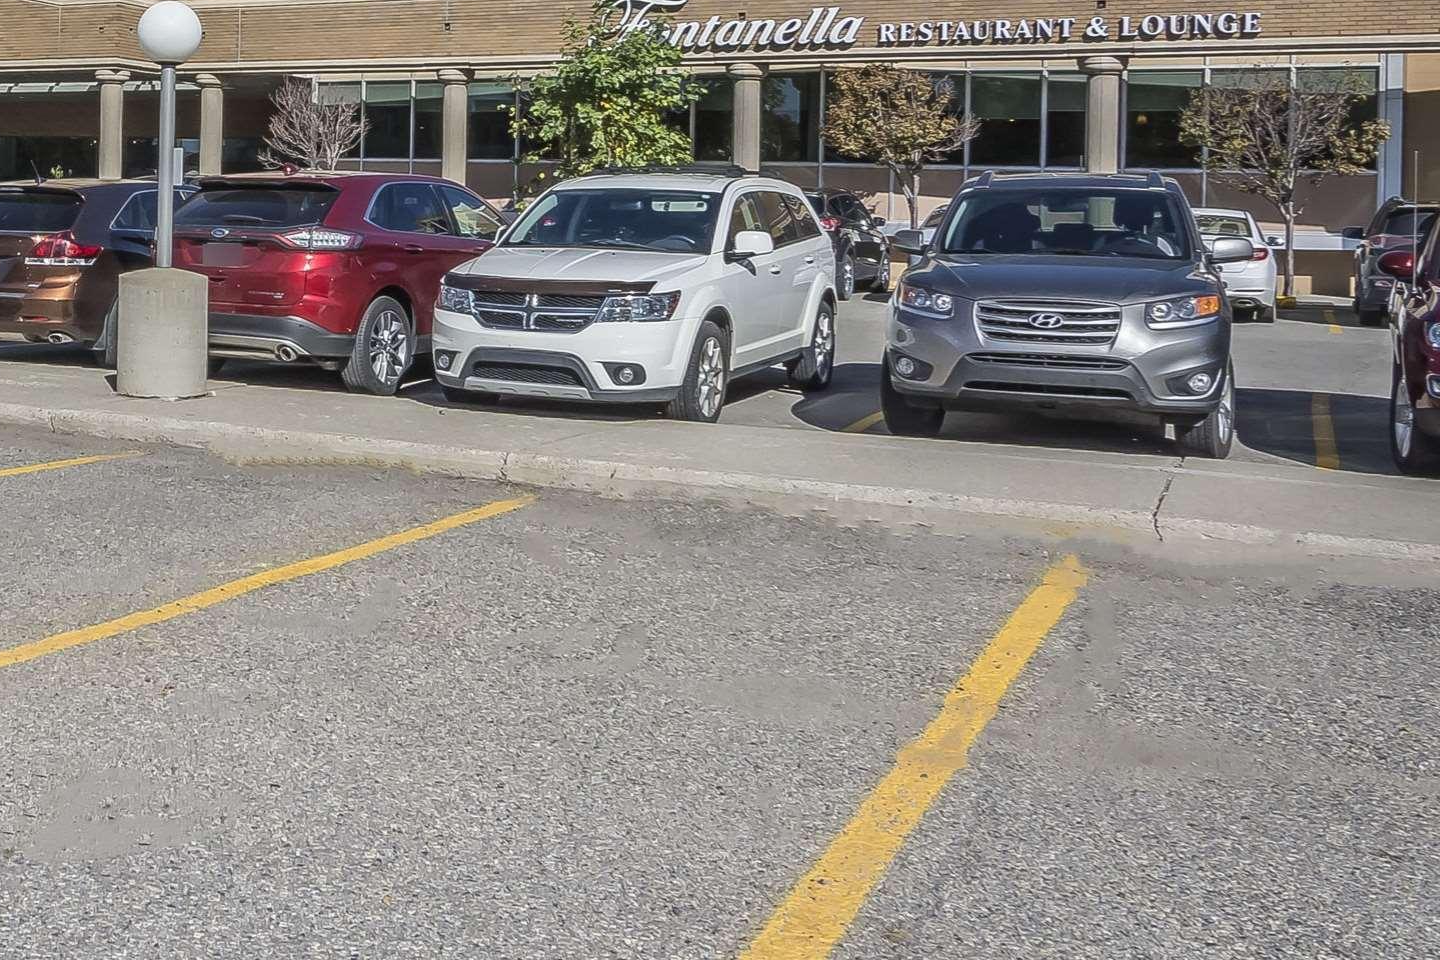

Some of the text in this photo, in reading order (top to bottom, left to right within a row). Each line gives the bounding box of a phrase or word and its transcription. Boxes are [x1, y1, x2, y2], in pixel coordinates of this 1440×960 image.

[878, 17, 1076, 43] RESTAURANT
[1085, 16, 1109, 38] &
[1120, 11, 1263, 37] LOUNGE
